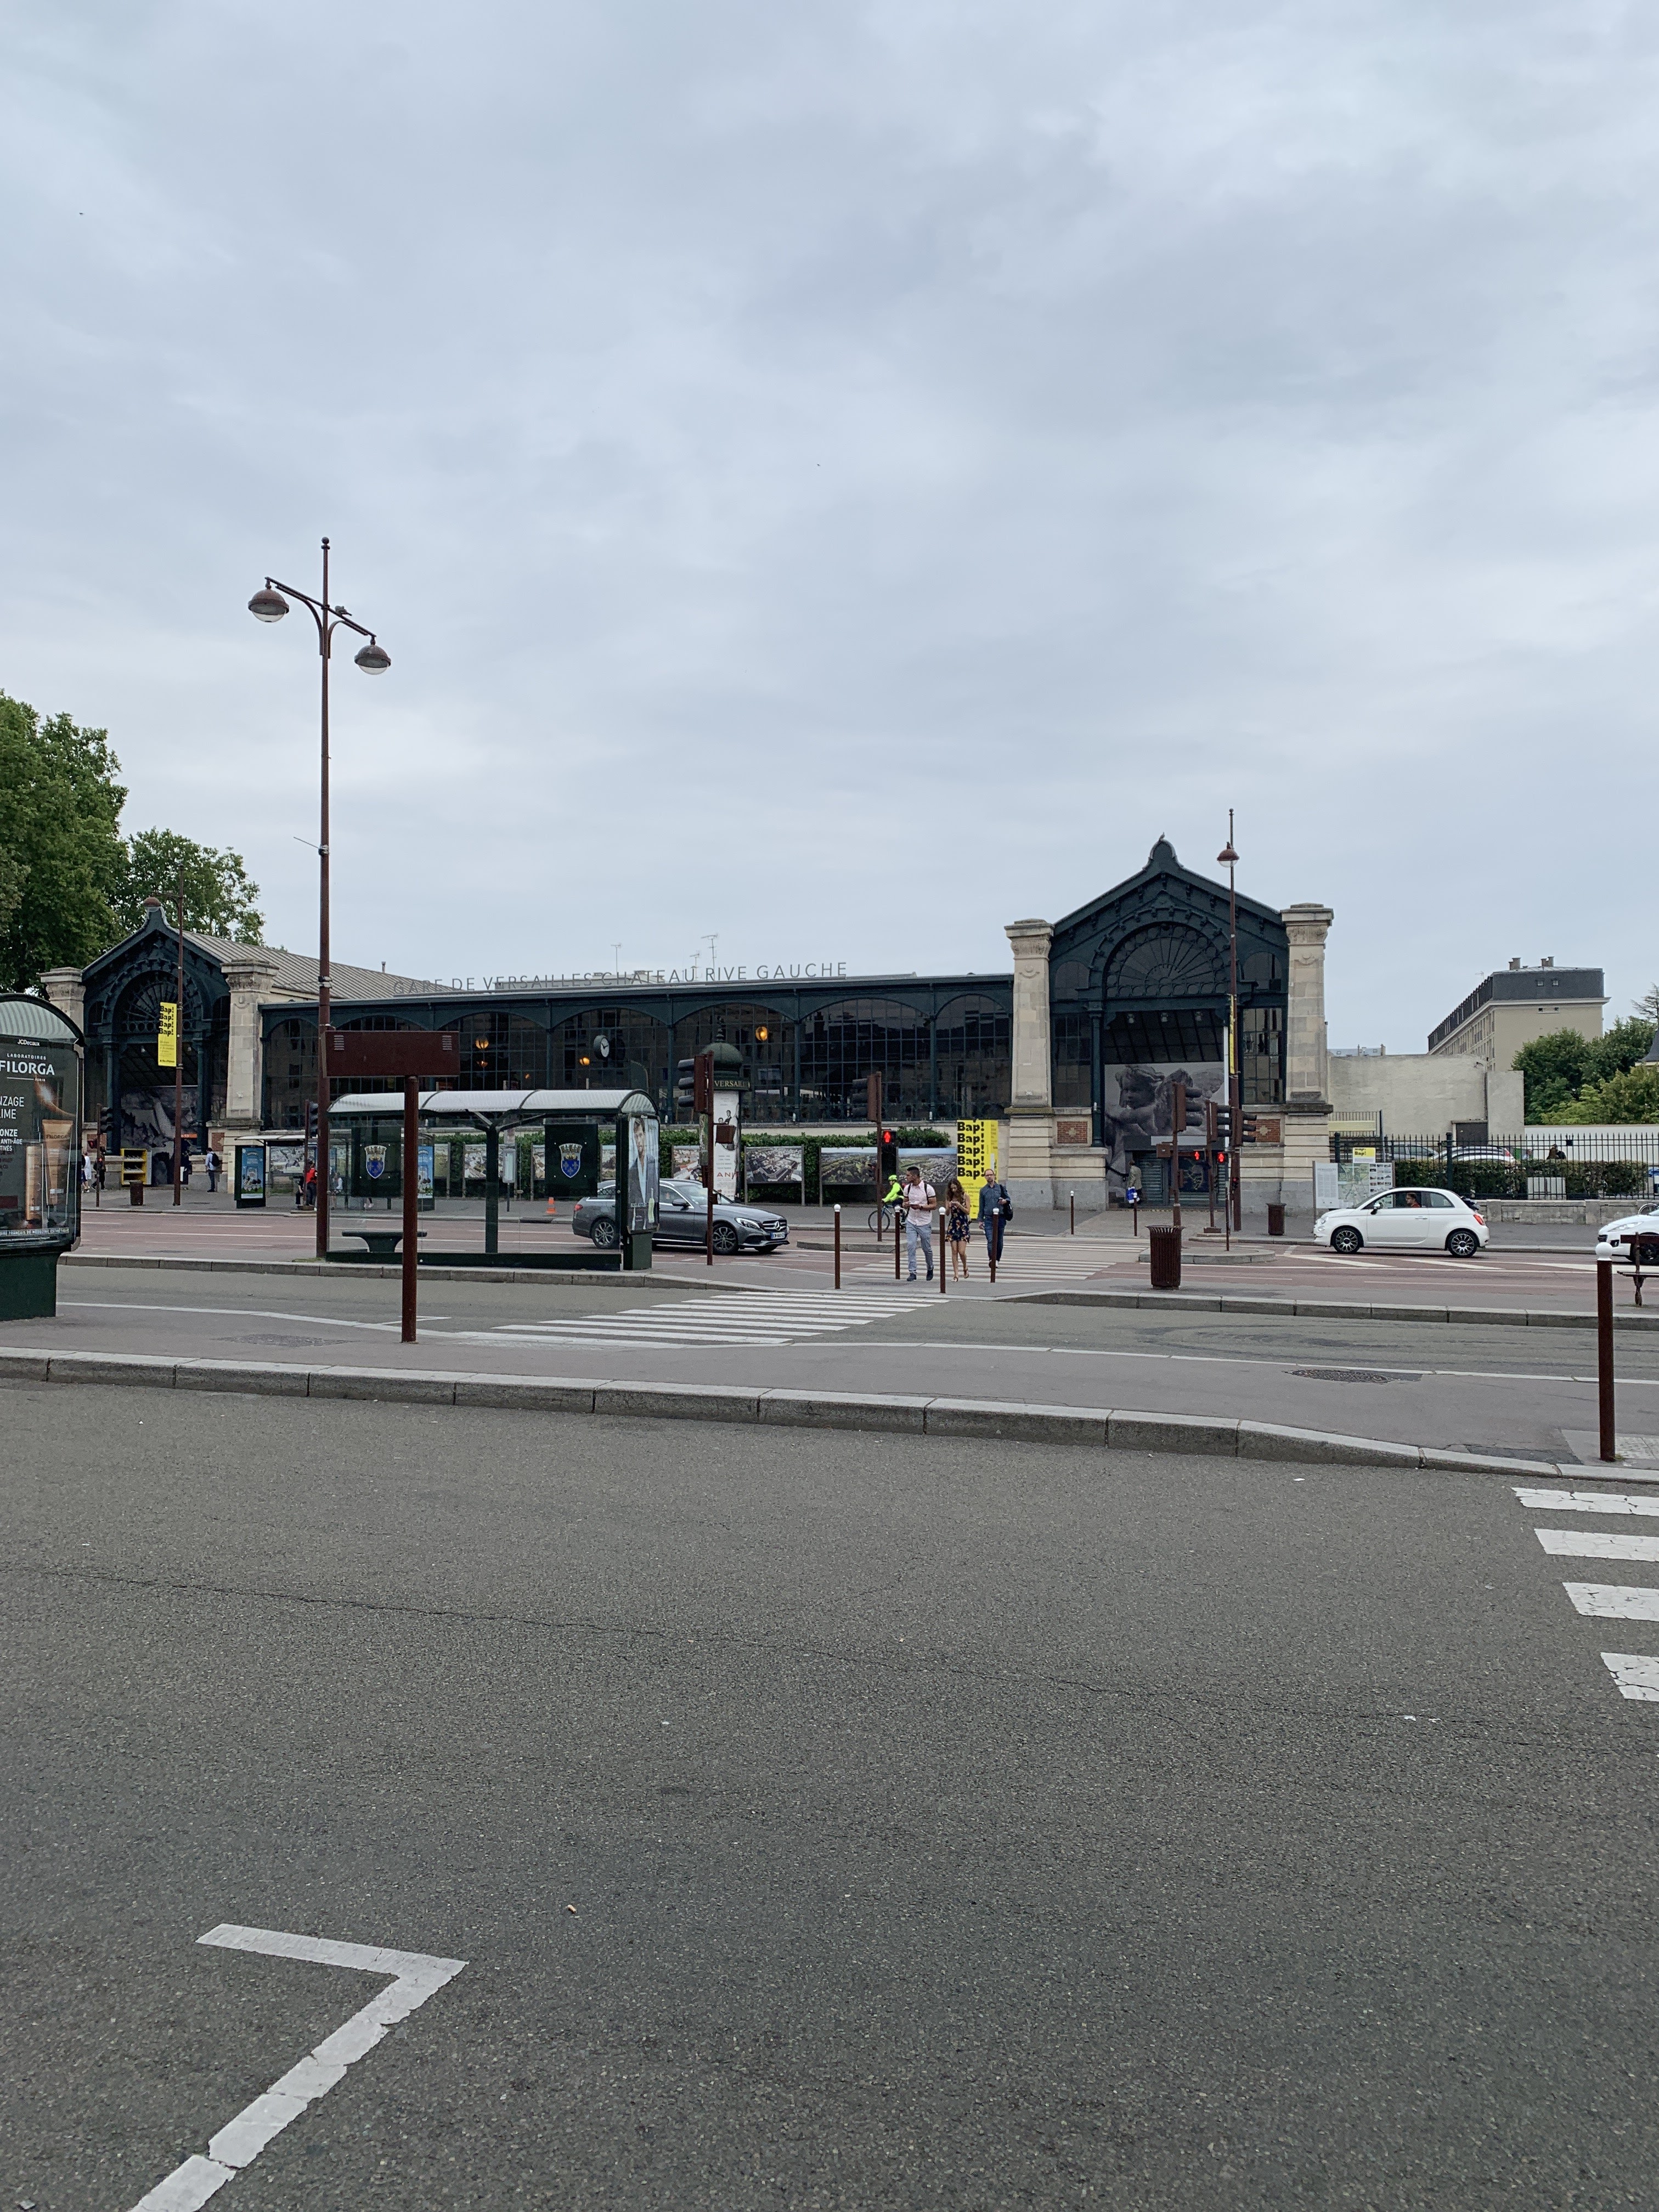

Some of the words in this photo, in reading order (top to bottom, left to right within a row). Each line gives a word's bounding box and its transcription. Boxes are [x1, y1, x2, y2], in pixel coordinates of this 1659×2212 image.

[393, 979, 442, 994] GARE
[452, 978, 475, 991] DE
[483, 973, 592, 990] VERSAILLES
[601, 968, 695, 986] CHATEAU
[706, 966, 747, 981] RIVE
[757, 962, 847, 979] GAUCHE
[160, 1006, 174, 1014] Bap!
[160, 1013, 174, 1022] Bap!
[159, 1020, 174, 1029] Bap!
[159, 1028, 174, 1036] Bap!
[0, 1060, 55, 1075] FILORGA
[0, 1109, 16, 1119] IME
[0, 1128, 18, 1137] ONZE
[957, 1121, 985, 1134] Bap!
[957, 1133, 985, 1146] Bap!
[957, 1144, 985, 1157] Bap!
[957, 1155, 985, 1169] Bap!
[957, 1167, 985, 1180] Bap!
